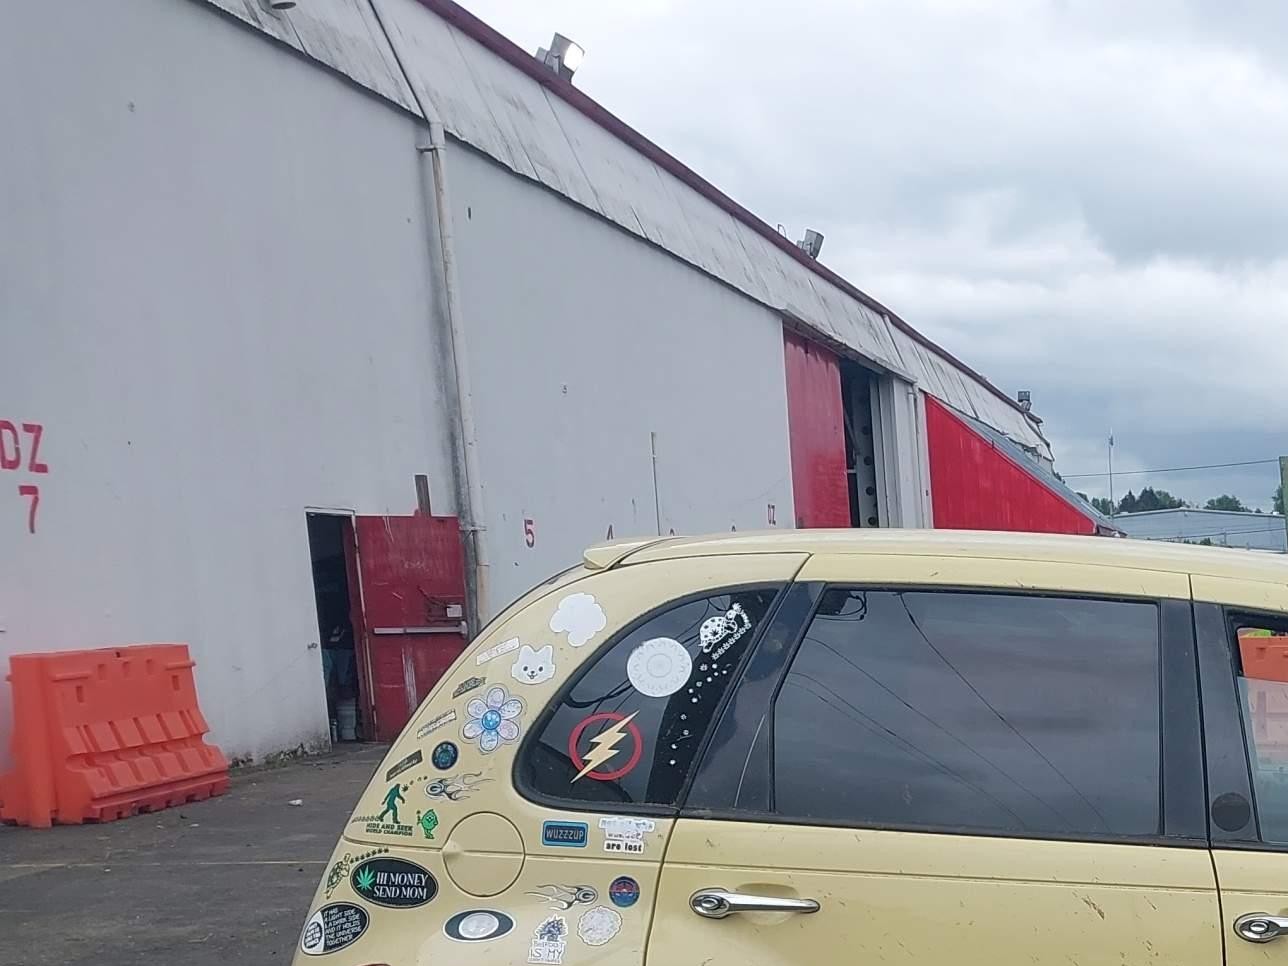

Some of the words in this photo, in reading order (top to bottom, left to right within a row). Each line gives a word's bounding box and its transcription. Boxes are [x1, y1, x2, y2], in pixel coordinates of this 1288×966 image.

[0, 420, 48, 473] DZ
[18, 485, 39, 534] 7
[524, 519, 535, 548] 5
[546, 829, 584, 840] WUZZZUP
[606, 842, 621, 851] are
[624, 842, 642, 852] lost
[389, 872, 428, 886] MONEY
[374, 885, 399, 898] SEND
[401, 886, 427, 900] MOM
[531, 947, 541, 958] IS
[547, 948, 562, 959] MY
